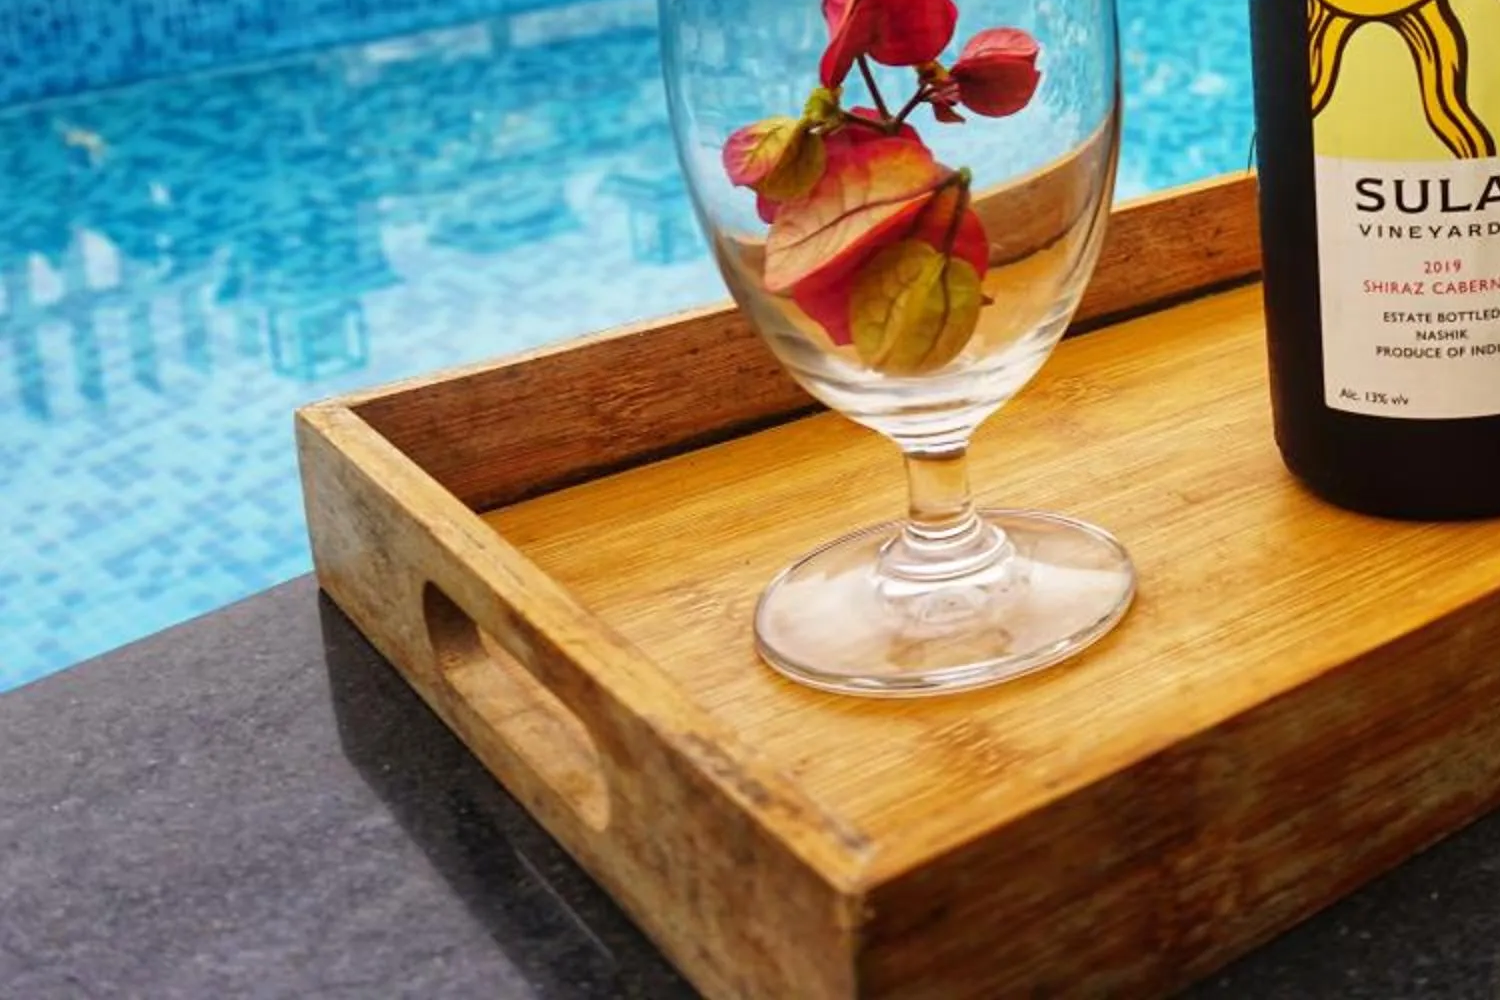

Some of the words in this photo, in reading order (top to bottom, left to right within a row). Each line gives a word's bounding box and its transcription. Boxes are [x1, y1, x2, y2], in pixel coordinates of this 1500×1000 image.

[1423, 259, 1463, 275] 2019
[1363, 280, 1425, 295] SHIRAZ
[1383, 311, 1433, 324] ESTATE
[1437, 307, 1500, 323] BOTTLED
[1416, 329, 1469, 341] NASHIK
[1376, 345, 1442, 359] PRODUCE
[1447, 347, 1465, 358] OF
[1365, 391, 1389, 405] 13%
